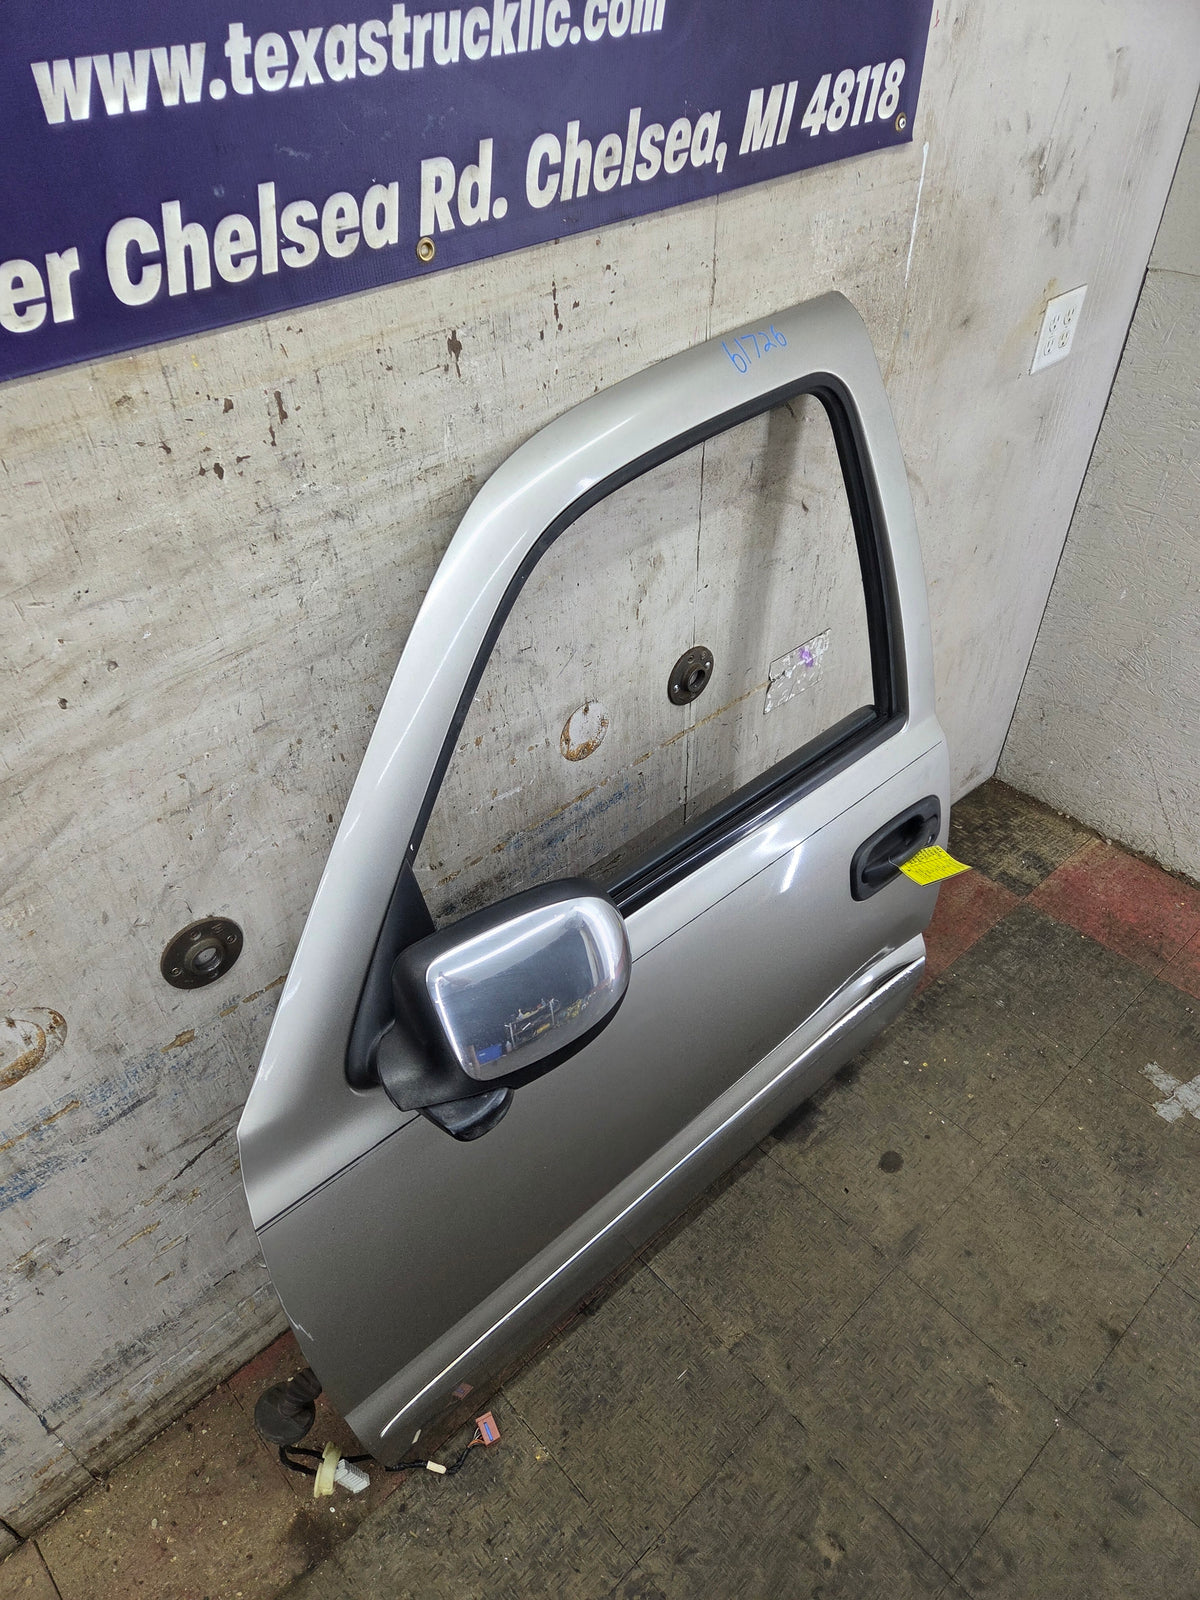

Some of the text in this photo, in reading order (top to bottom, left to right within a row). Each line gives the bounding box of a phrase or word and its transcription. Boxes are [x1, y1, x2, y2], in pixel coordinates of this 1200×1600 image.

[31, 0, 666, 125] www.texastruckllc.com
[106, 181, 400, 306] Chelsea
[419, 138, 508, 237] Rd.
[525, 107, 727, 208] Chelsea,
[739, 80, 798, 156] MI
[801, 58, 906, 137] 48118
